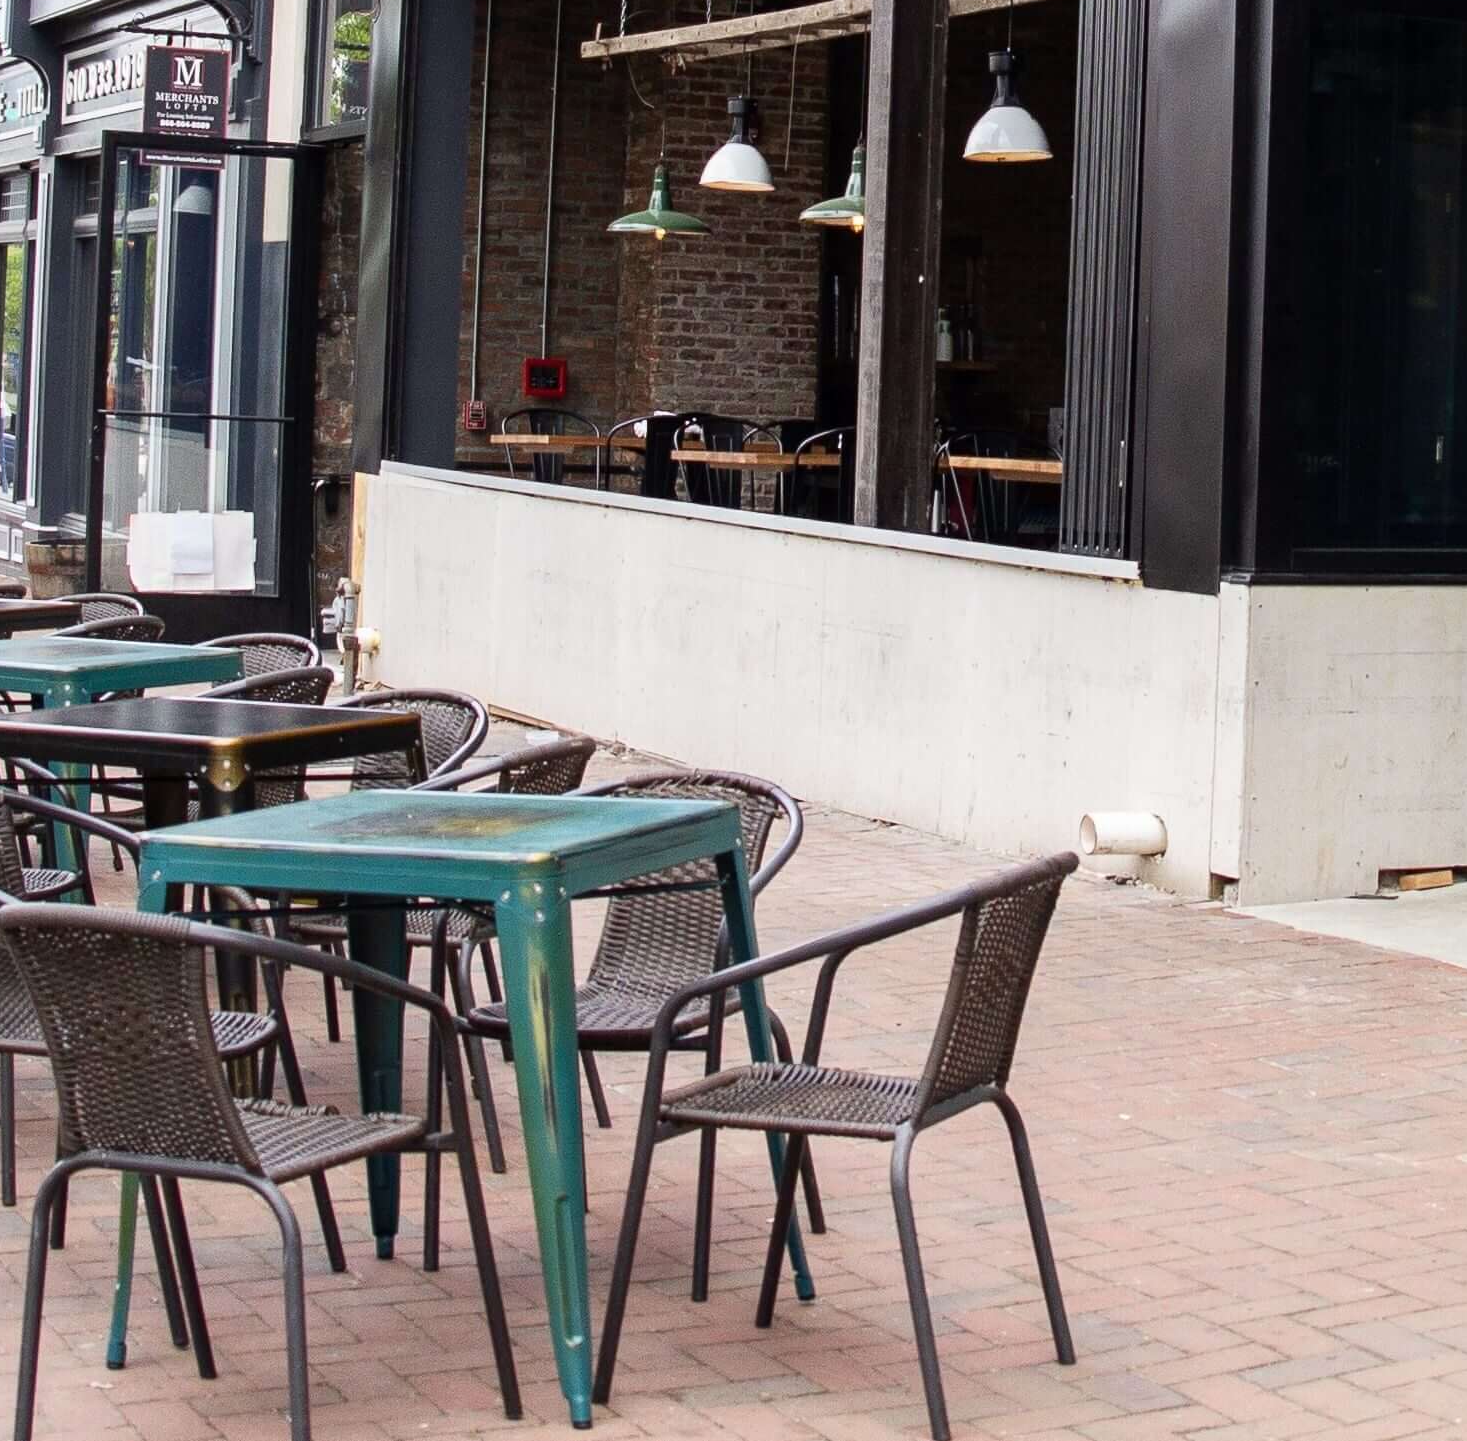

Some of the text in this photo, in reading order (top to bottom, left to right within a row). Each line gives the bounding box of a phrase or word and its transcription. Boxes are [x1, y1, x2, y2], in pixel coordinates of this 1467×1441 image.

[173, 57, 204, 87] M
[155, 91, 219, 105] MERCHANTS
[165, 102, 207, 112] LOFTS
